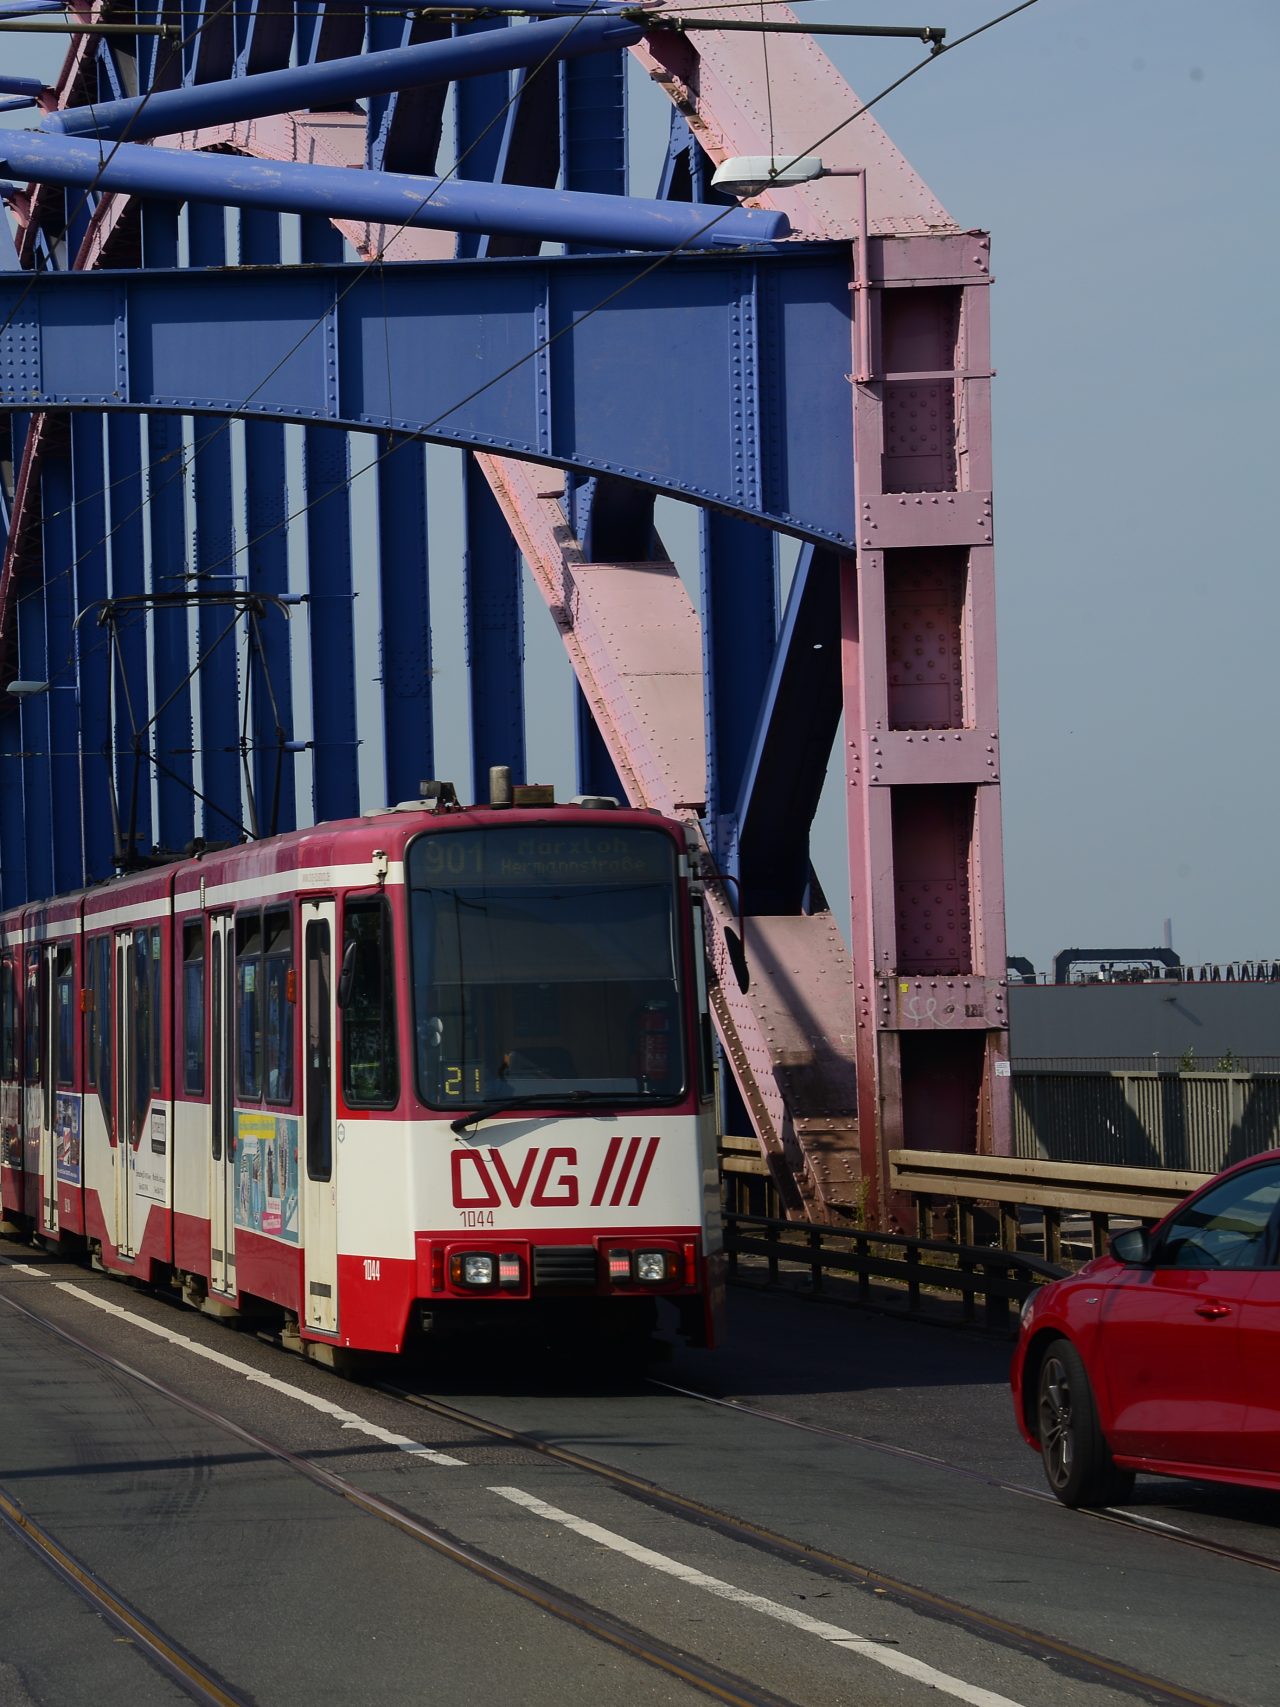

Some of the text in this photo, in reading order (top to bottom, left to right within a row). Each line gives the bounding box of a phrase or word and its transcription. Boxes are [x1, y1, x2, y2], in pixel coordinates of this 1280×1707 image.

[517, 837, 628, 855] Marxloh
[425, 842, 483, 875] 901
[502, 856, 646, 874] Hermannstraße
[450, 1148, 579, 1208] DVG
[459, 1210, 494, 1227] 1044
[363, 1260, 381, 1281] 1044
